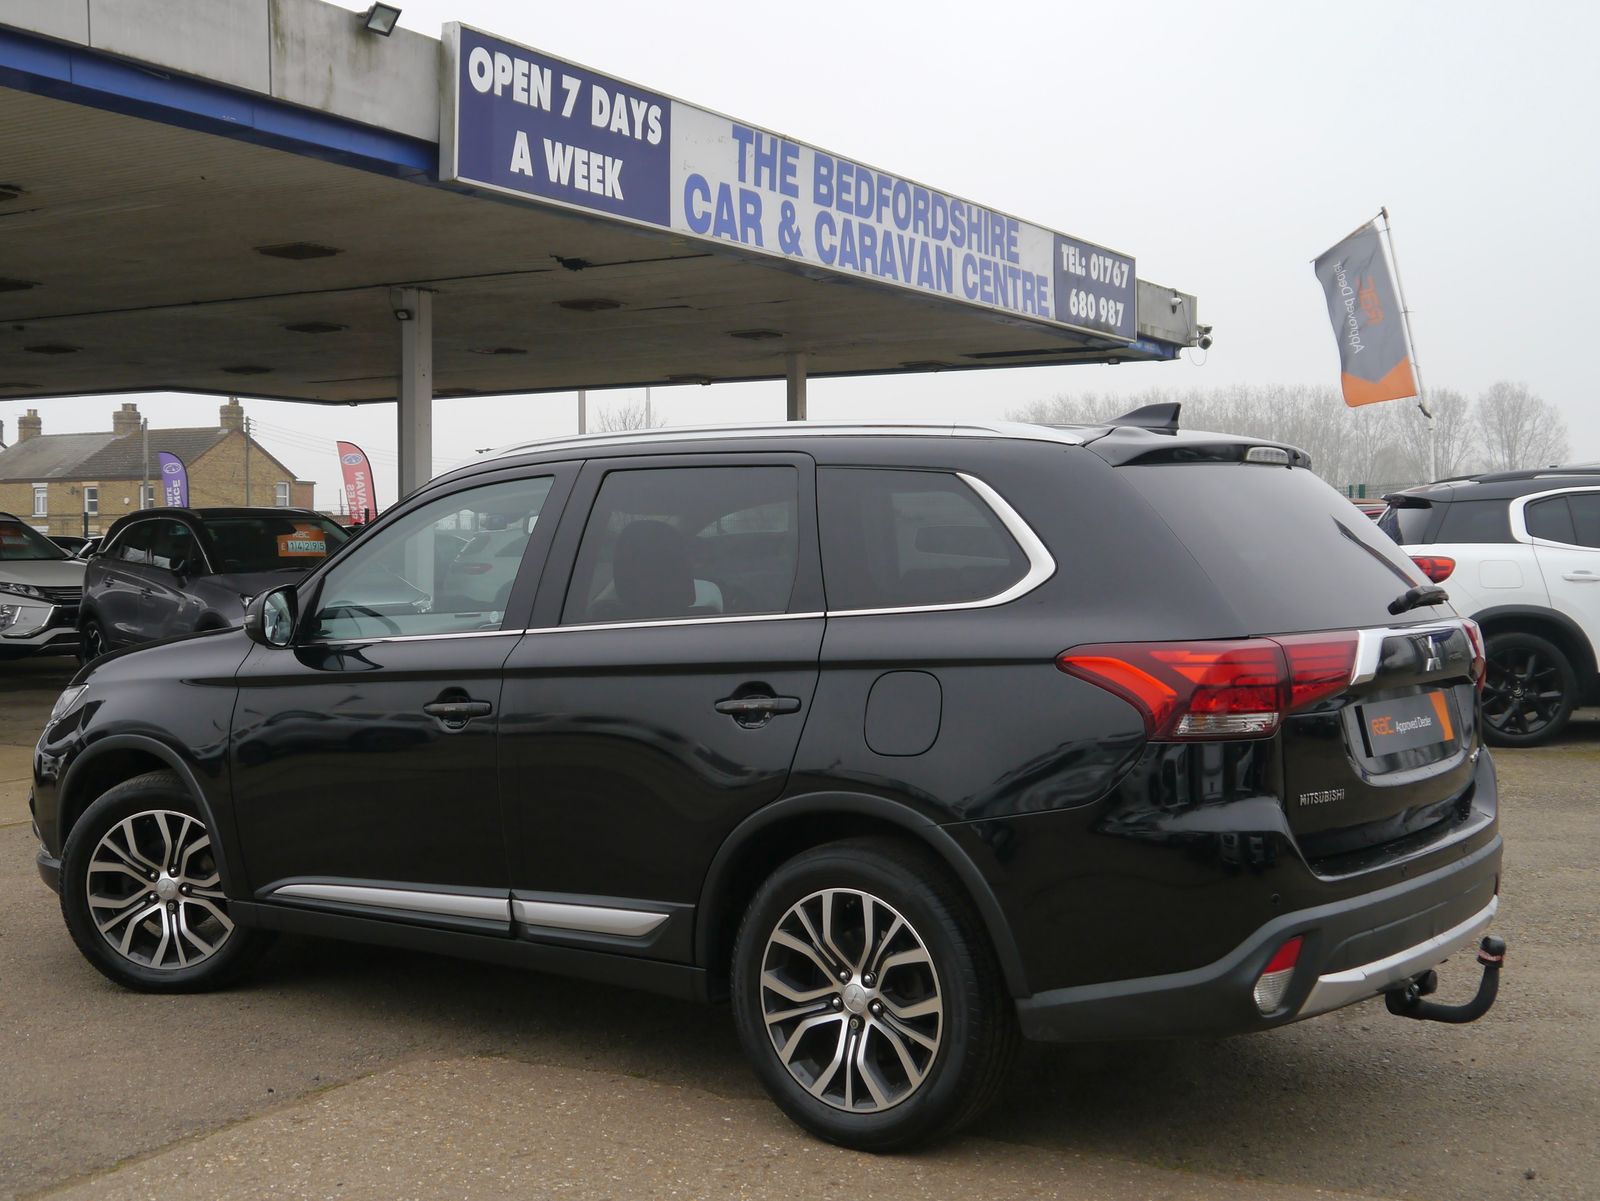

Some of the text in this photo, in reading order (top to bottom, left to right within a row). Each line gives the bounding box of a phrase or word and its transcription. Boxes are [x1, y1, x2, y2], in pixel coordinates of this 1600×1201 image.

[468, 46, 662, 145] OPEN 7 DAYS
[509, 130, 624, 201] A WEEK
[732, 123, 1020, 265] THE BEDFORDSHIRE
[683, 173, 1050, 318] CAR & CARAVAN CENTRE
[1061, 243, 1129, 289] TEL: 01767
[1069, 288, 1125, 328] 680 987
[1300, 788, 1345, 806] MITSUBISHI
